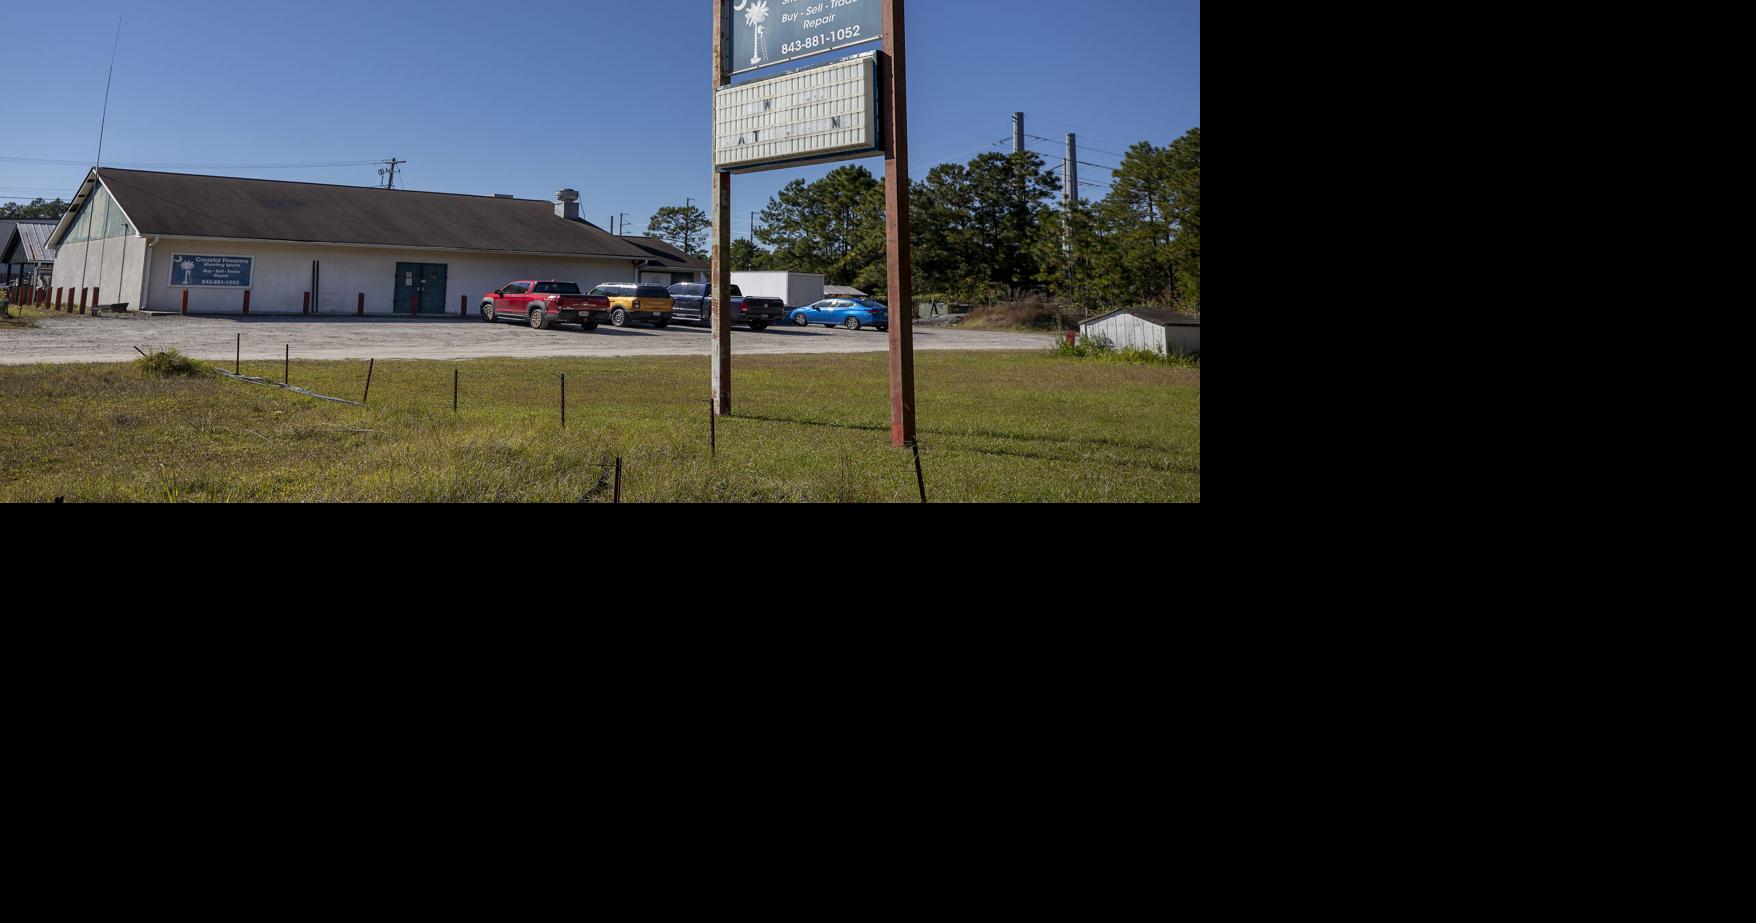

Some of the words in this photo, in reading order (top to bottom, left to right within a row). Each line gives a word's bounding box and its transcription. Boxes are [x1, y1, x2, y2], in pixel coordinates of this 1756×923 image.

[782, 11, 799, 23] Buy
[806, 3, 823, 16] Sell
[803, 13, 836, 30] Repair
[781, 25, 860, 54] 843-881-1052
